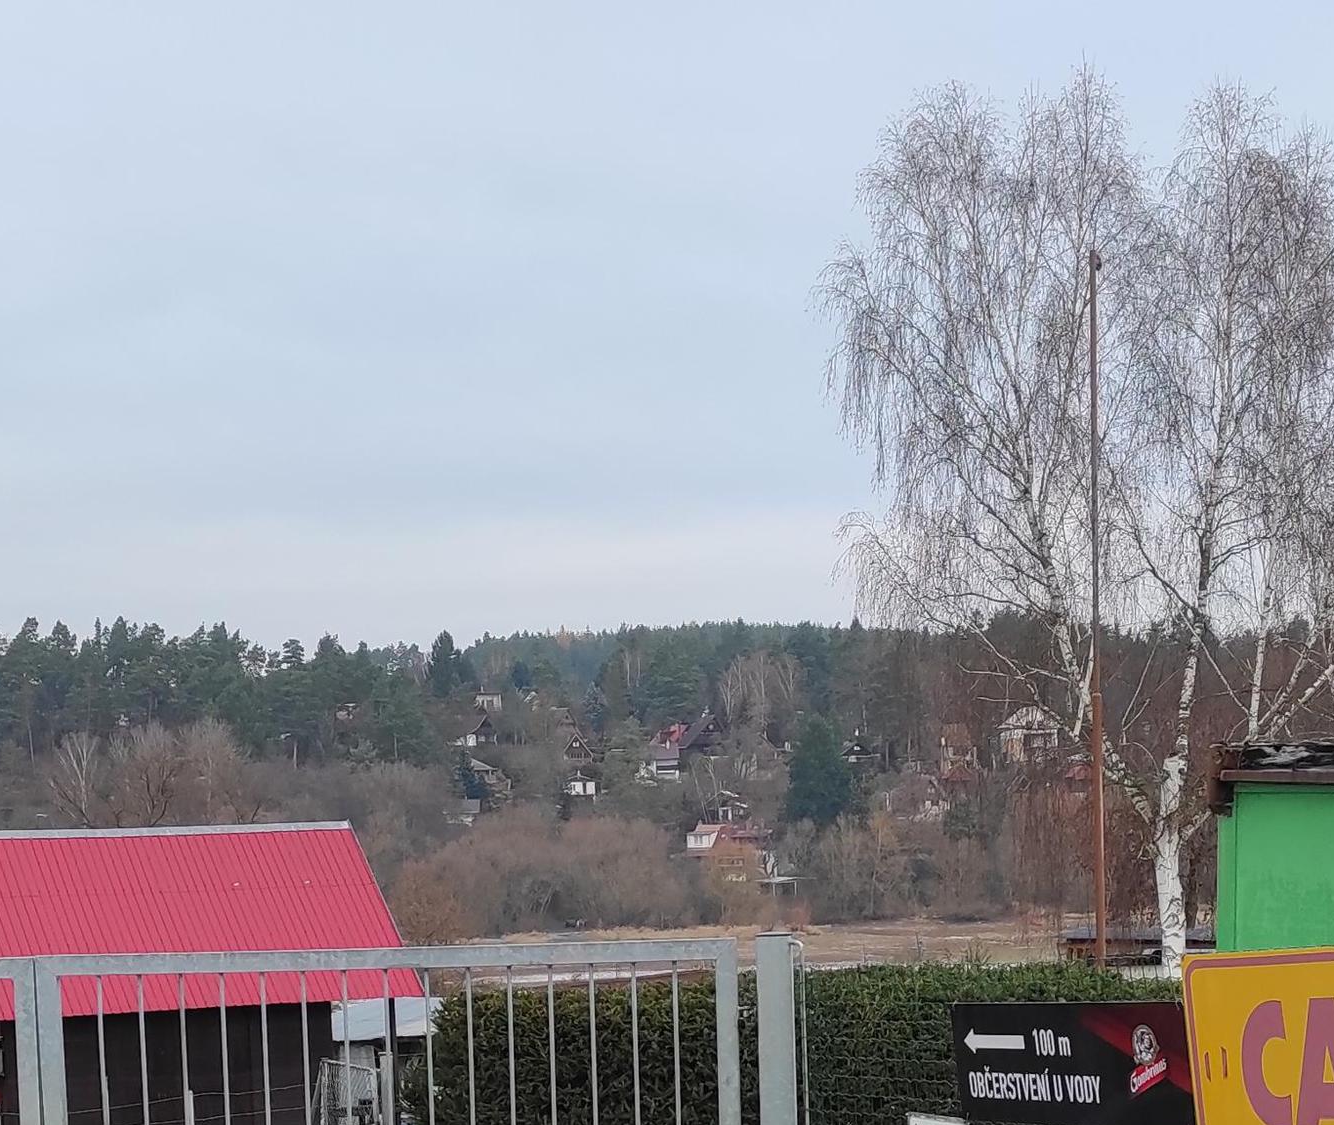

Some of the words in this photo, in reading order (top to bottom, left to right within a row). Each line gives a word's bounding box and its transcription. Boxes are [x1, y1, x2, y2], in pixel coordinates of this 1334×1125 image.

[1032, 1028, 1056, 1057] 100
[1058, 1035, 1072, 1057] m
[968, 1065, 1051, 1102] OBČERSTVENÍ
[1054, 1075, 1064, 1102] U
[1066, 1075, 1101, 1104] VODY
[1130, 1058, 1167, 1093] Gambrinus
